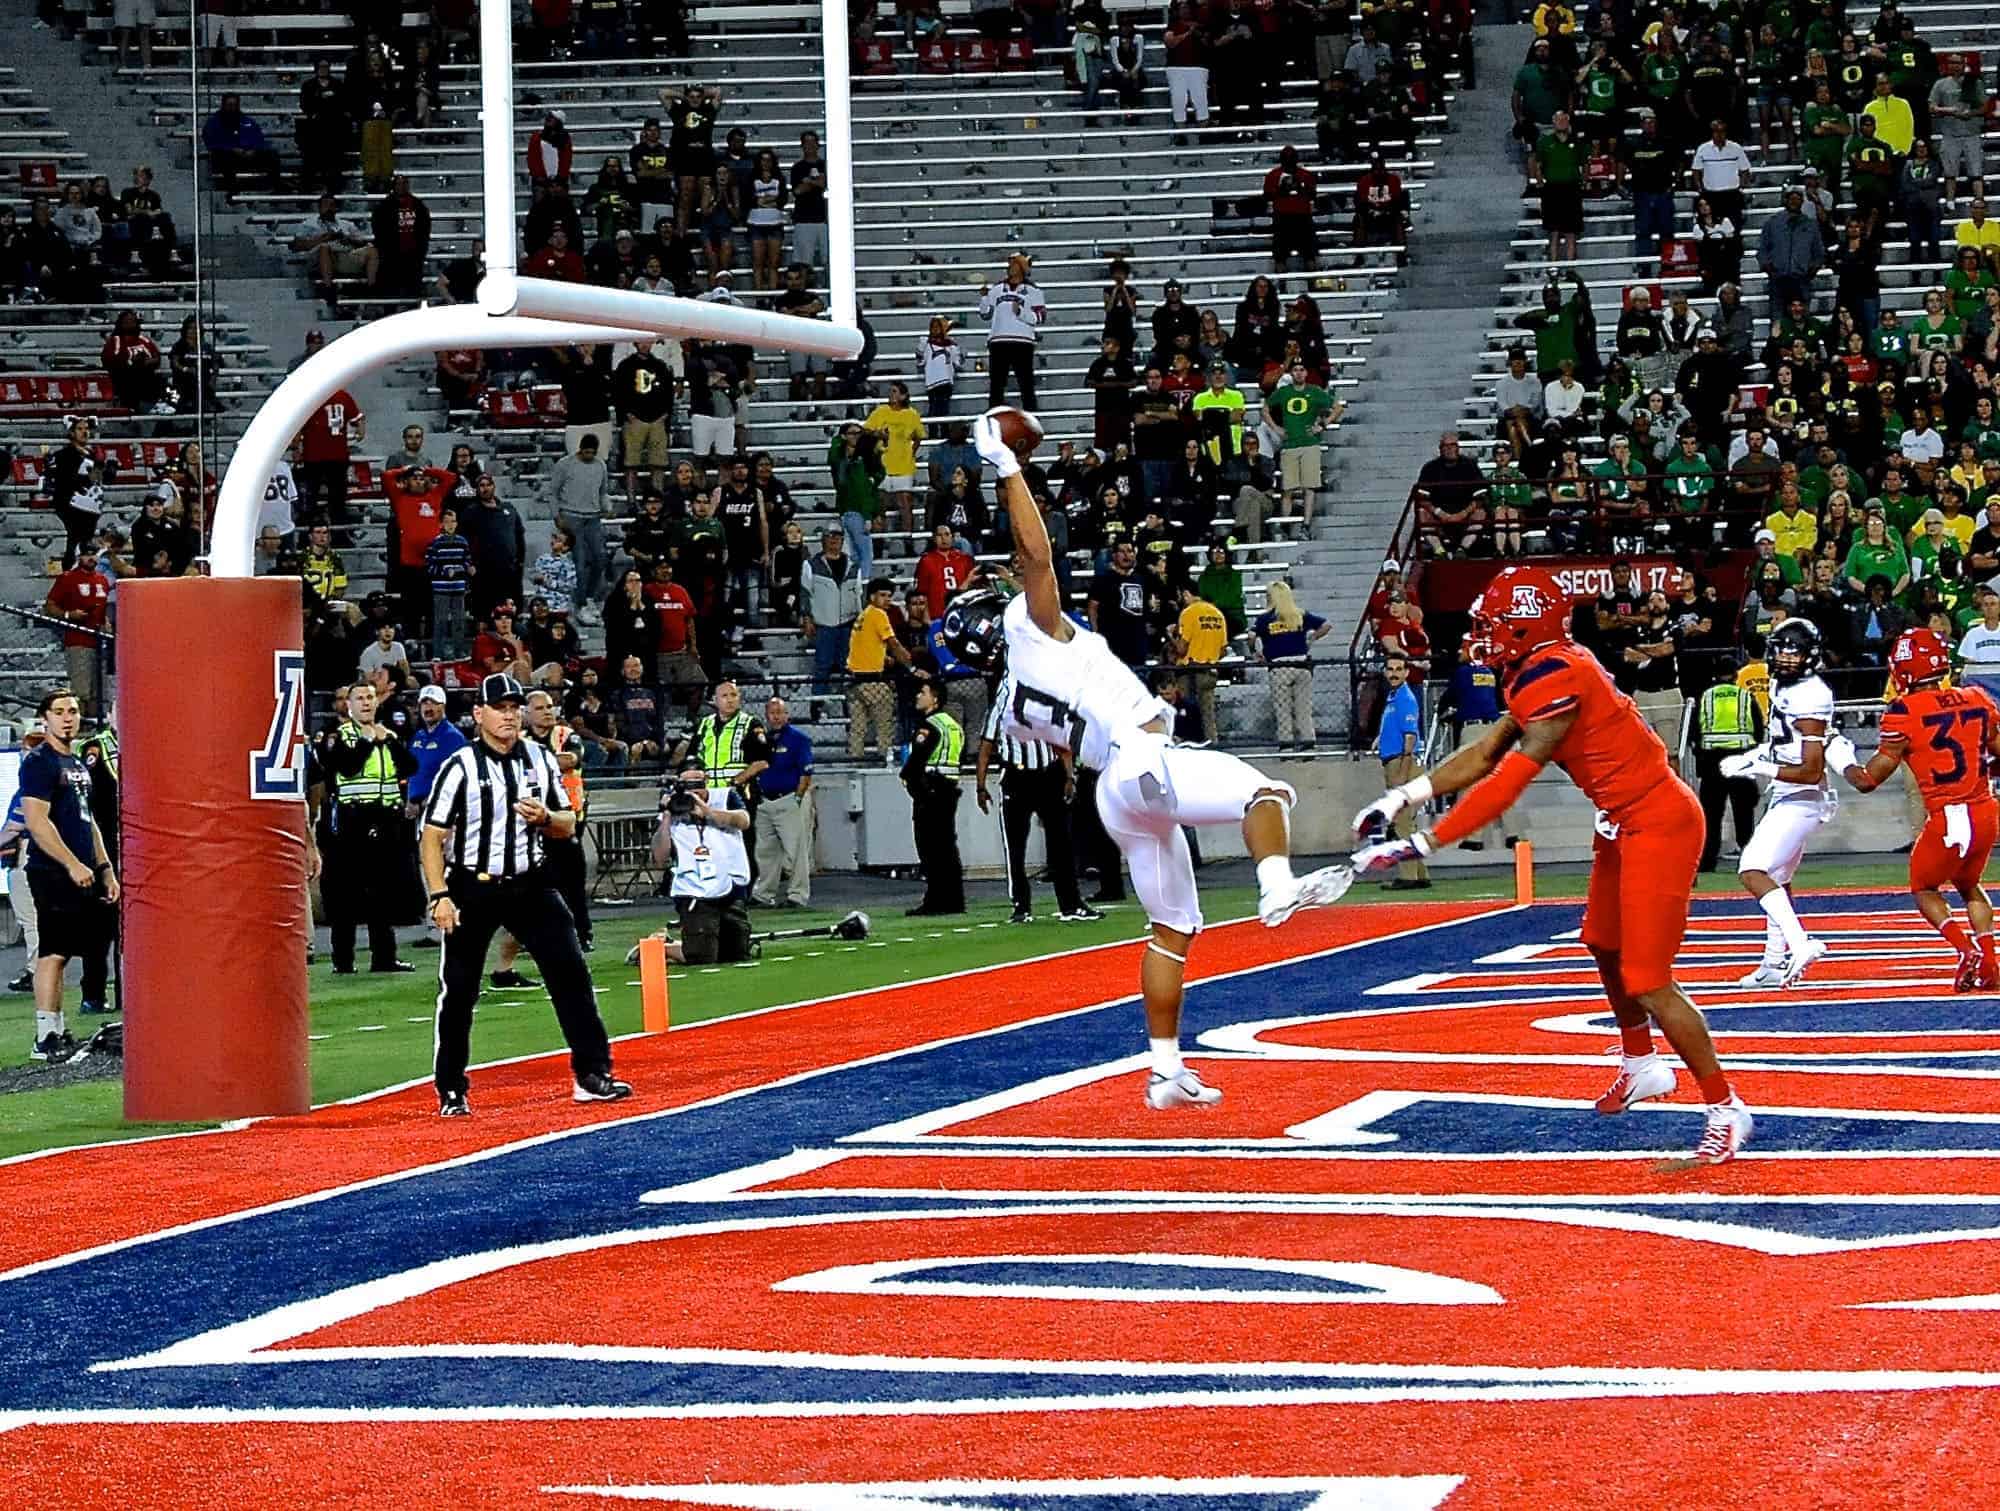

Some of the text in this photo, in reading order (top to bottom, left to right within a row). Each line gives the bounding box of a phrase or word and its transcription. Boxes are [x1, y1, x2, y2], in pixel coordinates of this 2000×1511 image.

[1287, 396, 1308, 415] O
[726, 503, 754, 514] HEAT
[1560, 568, 1641, 598] SECTIN
[1511, 585, 1542, 619] A
[1921, 706, 1988, 786] 37
